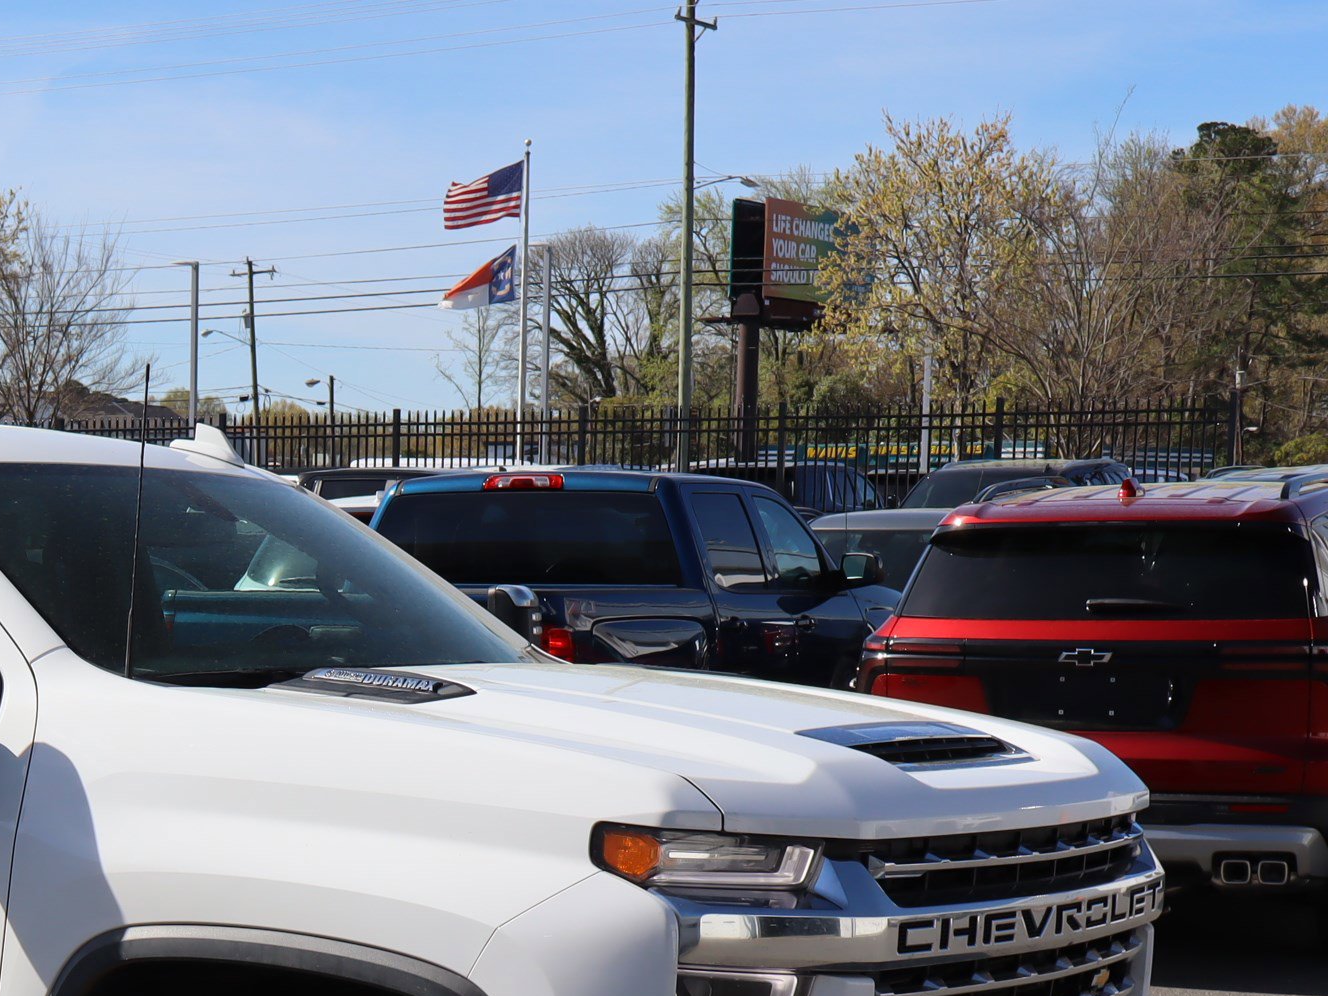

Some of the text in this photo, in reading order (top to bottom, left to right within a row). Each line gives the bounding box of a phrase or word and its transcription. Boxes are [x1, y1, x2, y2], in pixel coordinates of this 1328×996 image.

[772, 213, 791, 234] LIFE
[772, 238, 817, 263] YOUR CAR
[770, 262, 807, 284] SHOULD
[362, 673, 436, 692] DURAMAX
[896, 880, 1164, 954] CHEVROLET
